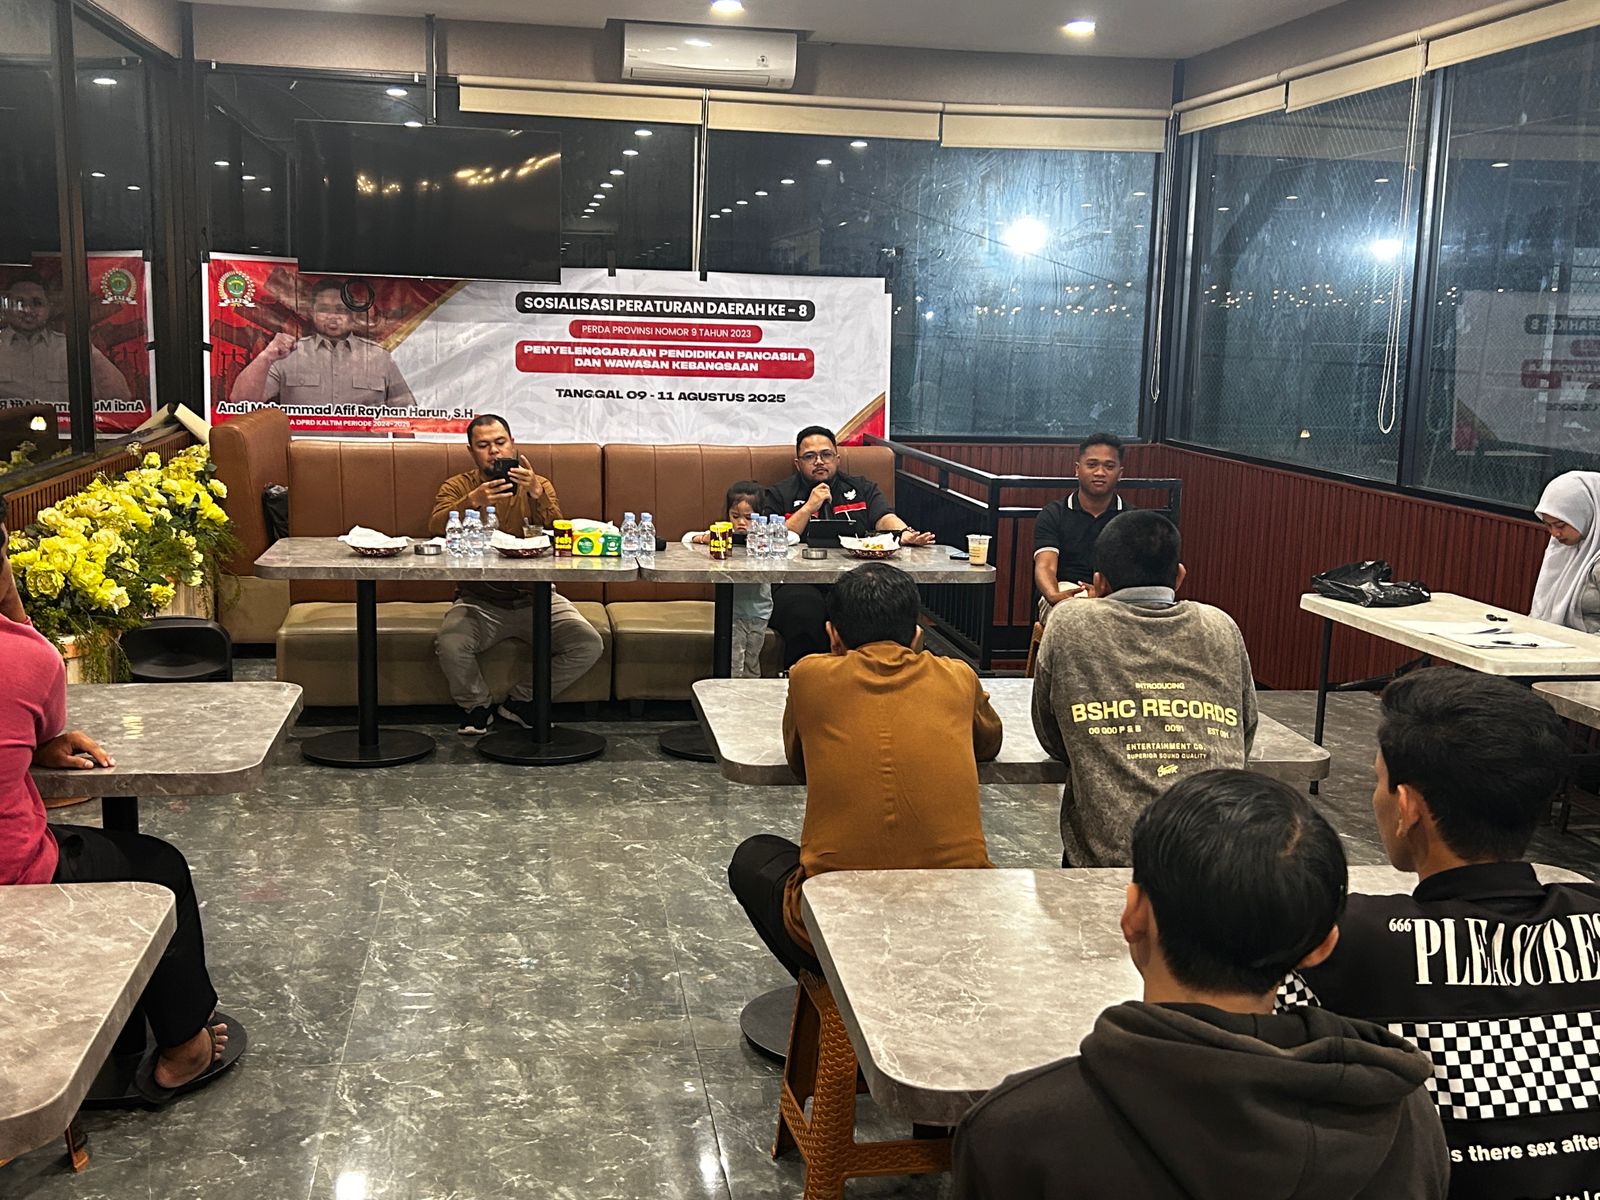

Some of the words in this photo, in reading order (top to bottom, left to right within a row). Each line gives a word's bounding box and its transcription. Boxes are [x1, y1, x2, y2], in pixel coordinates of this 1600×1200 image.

[524, 297, 614, 311] SOSIALISASI
[616, 299, 704, 314] PERATURAN
[707, 302, 765, 316] DAERAH
[768, 304, 786, 316] KE
[798, 304, 808, 318] 8
[582, 325, 610, 334] PERDA
[612, 326, 653, 335] PROVINSI
[655, 327, 689, 336] NOMOR
[691, 328, 697, 336] 9
[699, 328, 729, 337] TAHUN
[730, 329, 752, 338] 2023
[524, 345, 656, 357] PENYELENGGARAAN
[659, 348, 735, 360] PENDIDIKAN
[737, 351, 807, 361] PANCASILA
[574, 358, 601, 367] DAN
[604, 359, 669, 369] WAWASAN
[672, 361, 759, 372] KEBANGSAAN
[555, 389, 623, 399] TANGGAL
[626, 391, 648, 400] 09
[657, 391, 674, 400] 11
[678, 392, 745, 402] AGUSTUS
[748, 393, 786, 403] 2025
[217, 401, 249, 413] Andi
[250, 402, 332, 415] Mammad
[334, 404, 356, 416] Afif
[358, 404, 407, 419] Rayhan
[409, 406, 451, 419] Harun,
[453, 408, 473, 418] S.H
[343, 419, 372, 427] PERIODE
[1135, 682, 1186, 690] INTRODUCING
[1071, 699, 1138, 723] BSHC
[1142, 698, 1238, 727] RECORDS
[1126, 742, 1191, 751] ENTERTAINMENT
[1468, 1145, 1523, 1162] there
[1526, 1142, 1558, 1157] sex
